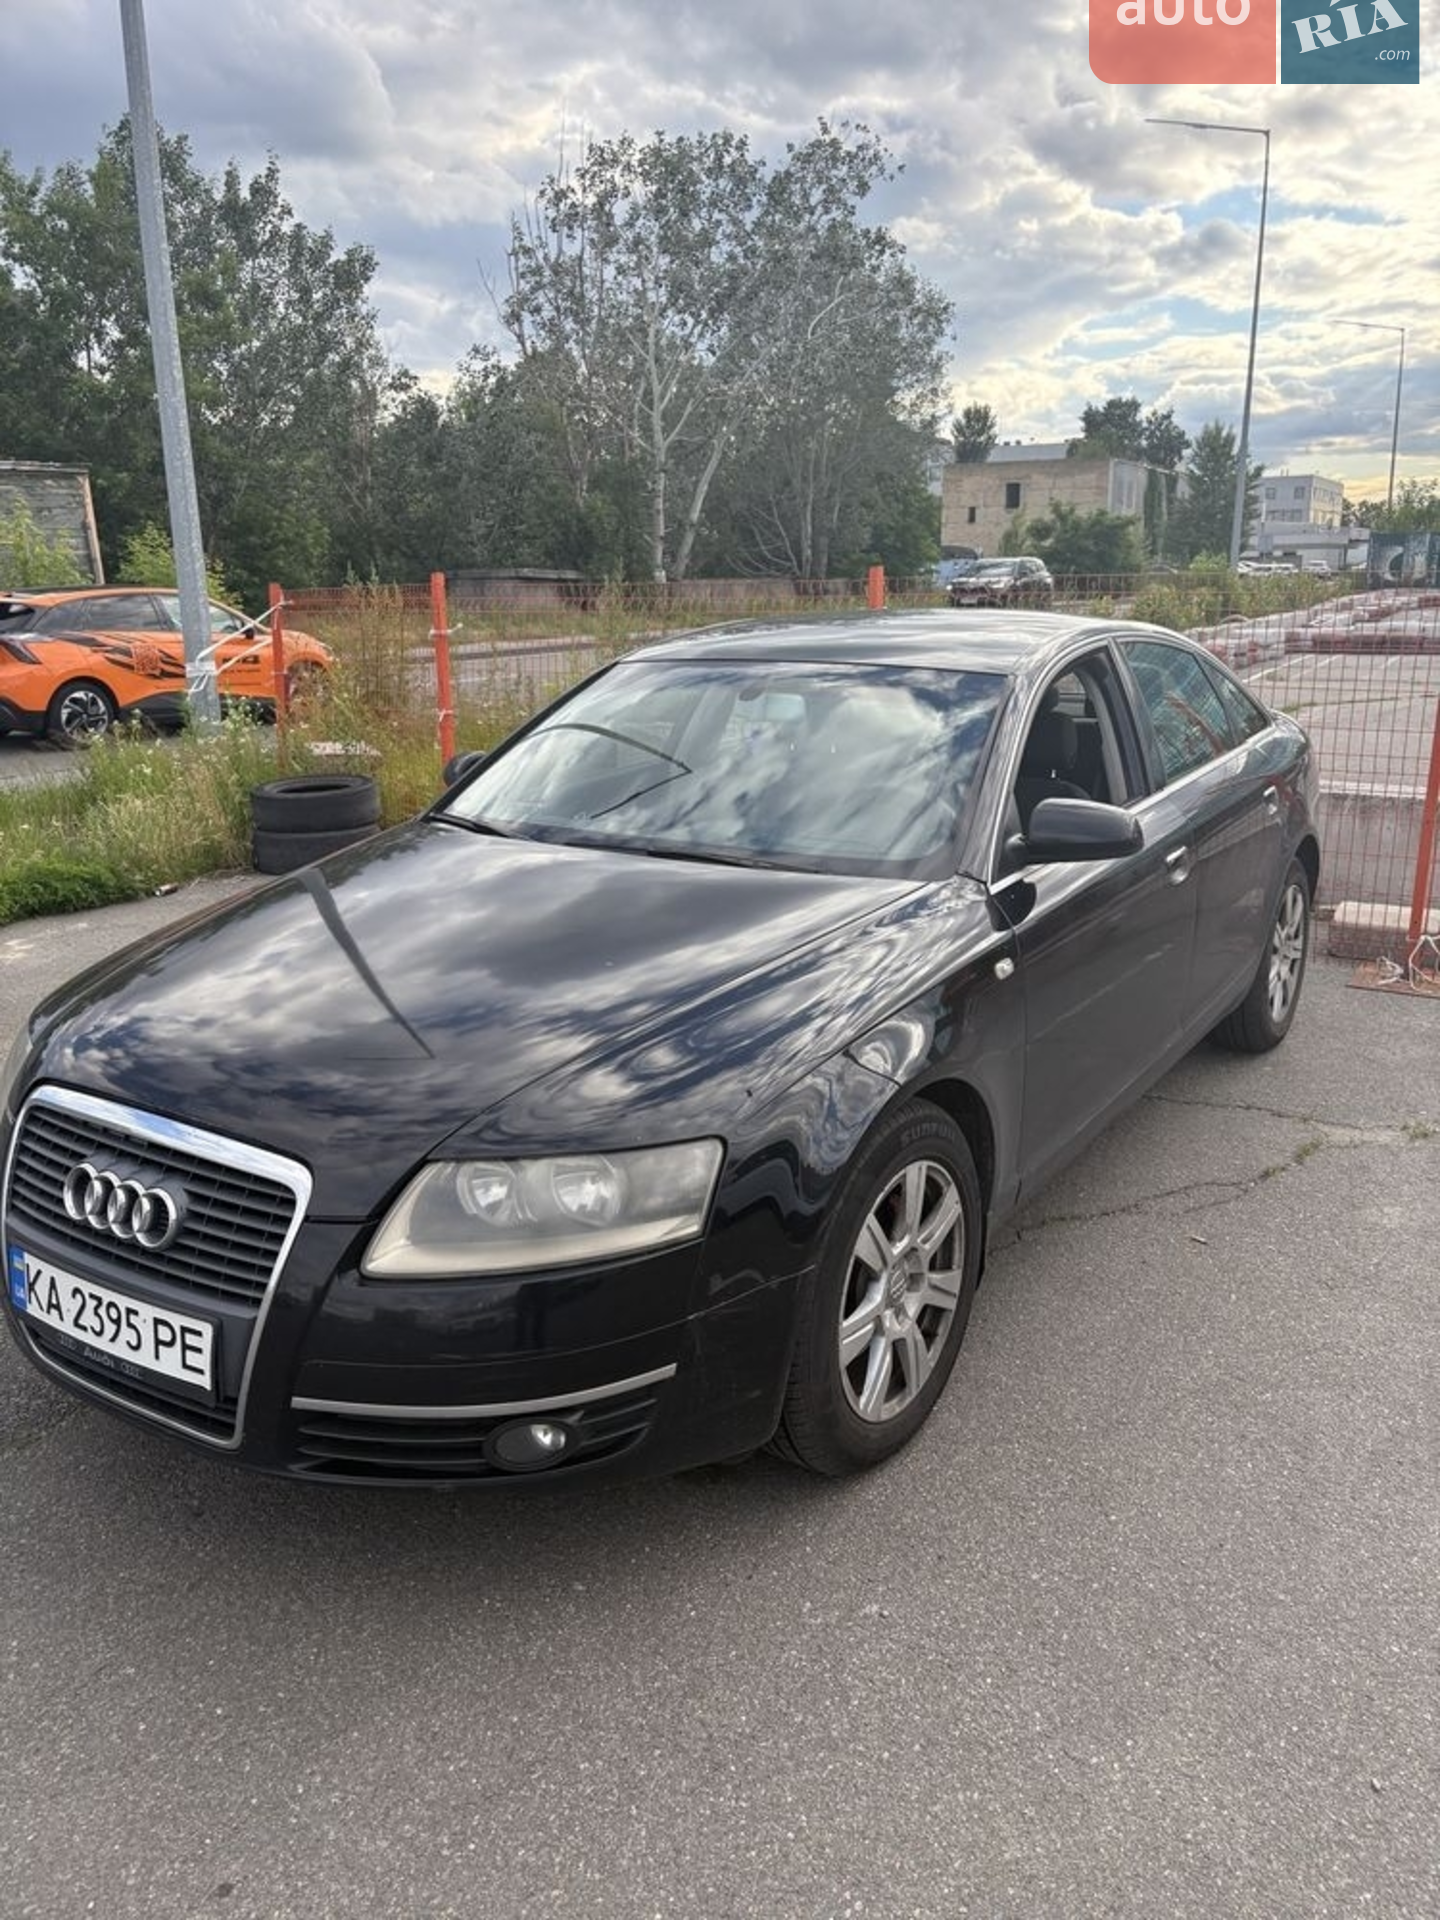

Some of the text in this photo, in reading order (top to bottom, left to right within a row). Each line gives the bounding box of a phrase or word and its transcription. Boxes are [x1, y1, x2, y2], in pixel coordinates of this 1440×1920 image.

[27, 1263, 205, 1376] KA 2395 PE
